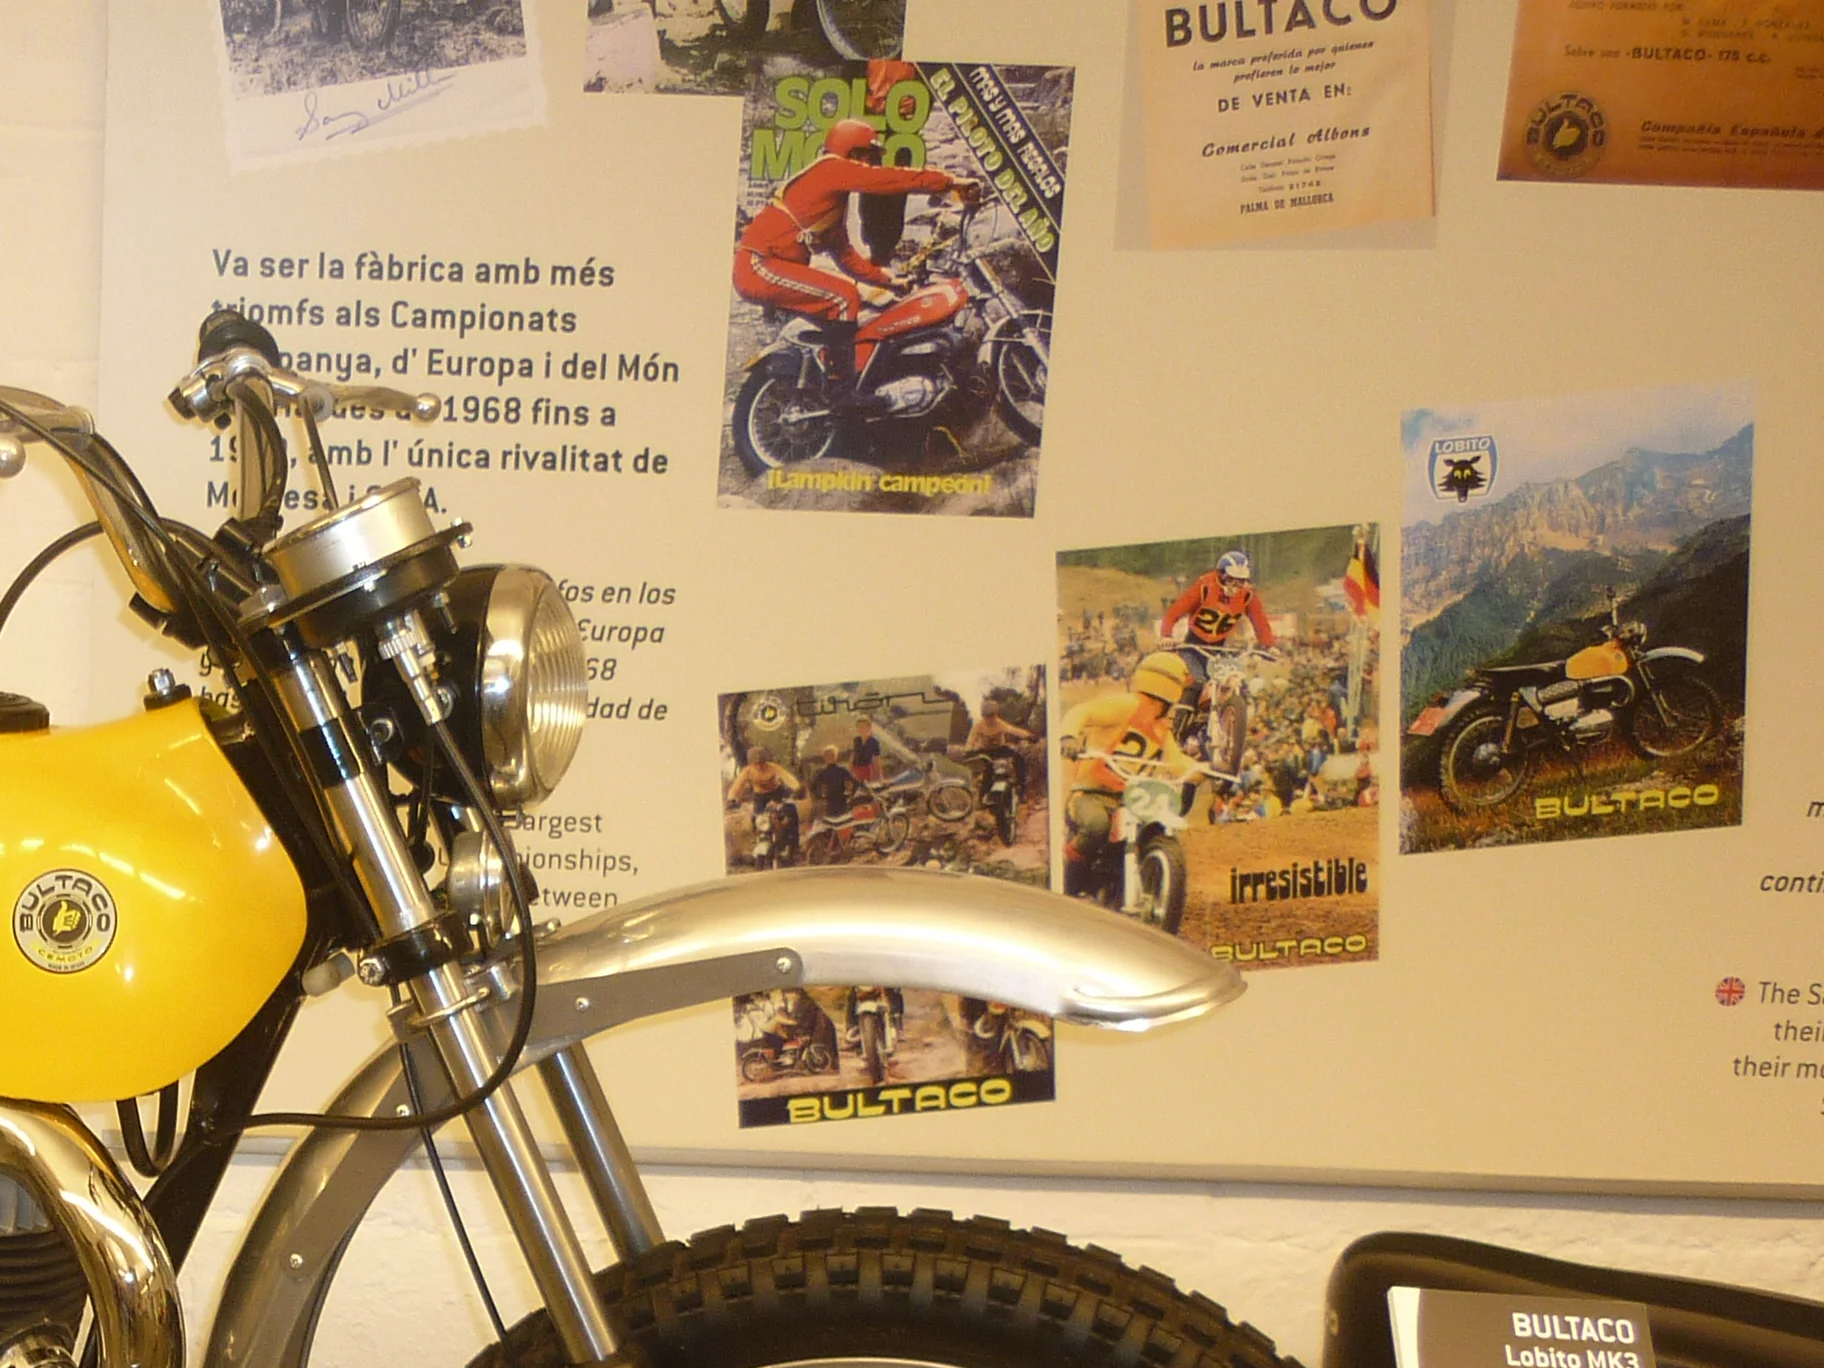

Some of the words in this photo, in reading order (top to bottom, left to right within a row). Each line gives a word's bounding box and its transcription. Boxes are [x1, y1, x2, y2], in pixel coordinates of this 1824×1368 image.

[1165, 0, 1398, 48] BULTACO
[1210, 57, 1246, 70] marca
[1250, 48, 1303, 72] preferida
[1307, 47, 1326, 59] por
[1331, 40, 1375, 56] quienes
[1233, 65, 1284, 84] prefieren
[1304, 60, 1336, 76] mejor
[774, 75, 931, 134] SOLO
[1218, 96, 1240, 113] DE
[1252, 87, 1311, 109] VENTA
[1201, 132, 1296, 158] Comercial
[1240, 201, 1269, 215] PALMA
[1275, 198, 1286, 210] DE
[1290, 192, 1335, 208] MALLORCA
[212, 248, 249, 277] Va
[259, 255, 309, 279] ser
[318, 251, 344, 279] la
[355, 251, 464, 283] fàbrica
[474, 256, 540, 285] amb
[549, 256, 616, 287] més
[335, 299, 381, 328] als
[390, 299, 578, 340] Campionats
[427, 348, 534, 387] Europa
[543, 351, 552, 379] i
[561, 352, 607, 381] del
[617, 352, 680, 383] Món
[442, 395, 522, 424] 1968
[531, 397, 590, 427] fins
[600, 405, 617, 427] a
[406, 437, 491, 469] única
[500, 442, 624, 474] rivalitat
[632, 446, 669, 475] de
[1434, 436, 1491, 454] LOBITO
[601, 586, 632, 604] en
[638, 581, 676, 605] los
[578, 618, 665, 651] Europa
[637, 697, 669, 721] de
[1534, 783, 1720, 821] BULTACO
[1229, 856, 1369, 905] irresistible
[19, 874, 112, 933] BULTACO
[1209, 933, 1368, 962] BULTACO
[1758, 980, 1801, 1005] The
[1774, 1019, 1824, 1043] thei
[1732, 1054, 1792, 1078] their
[786, 1078, 1013, 1124] BULTACO
[1511, 1311, 1636, 1344] BULTACO
